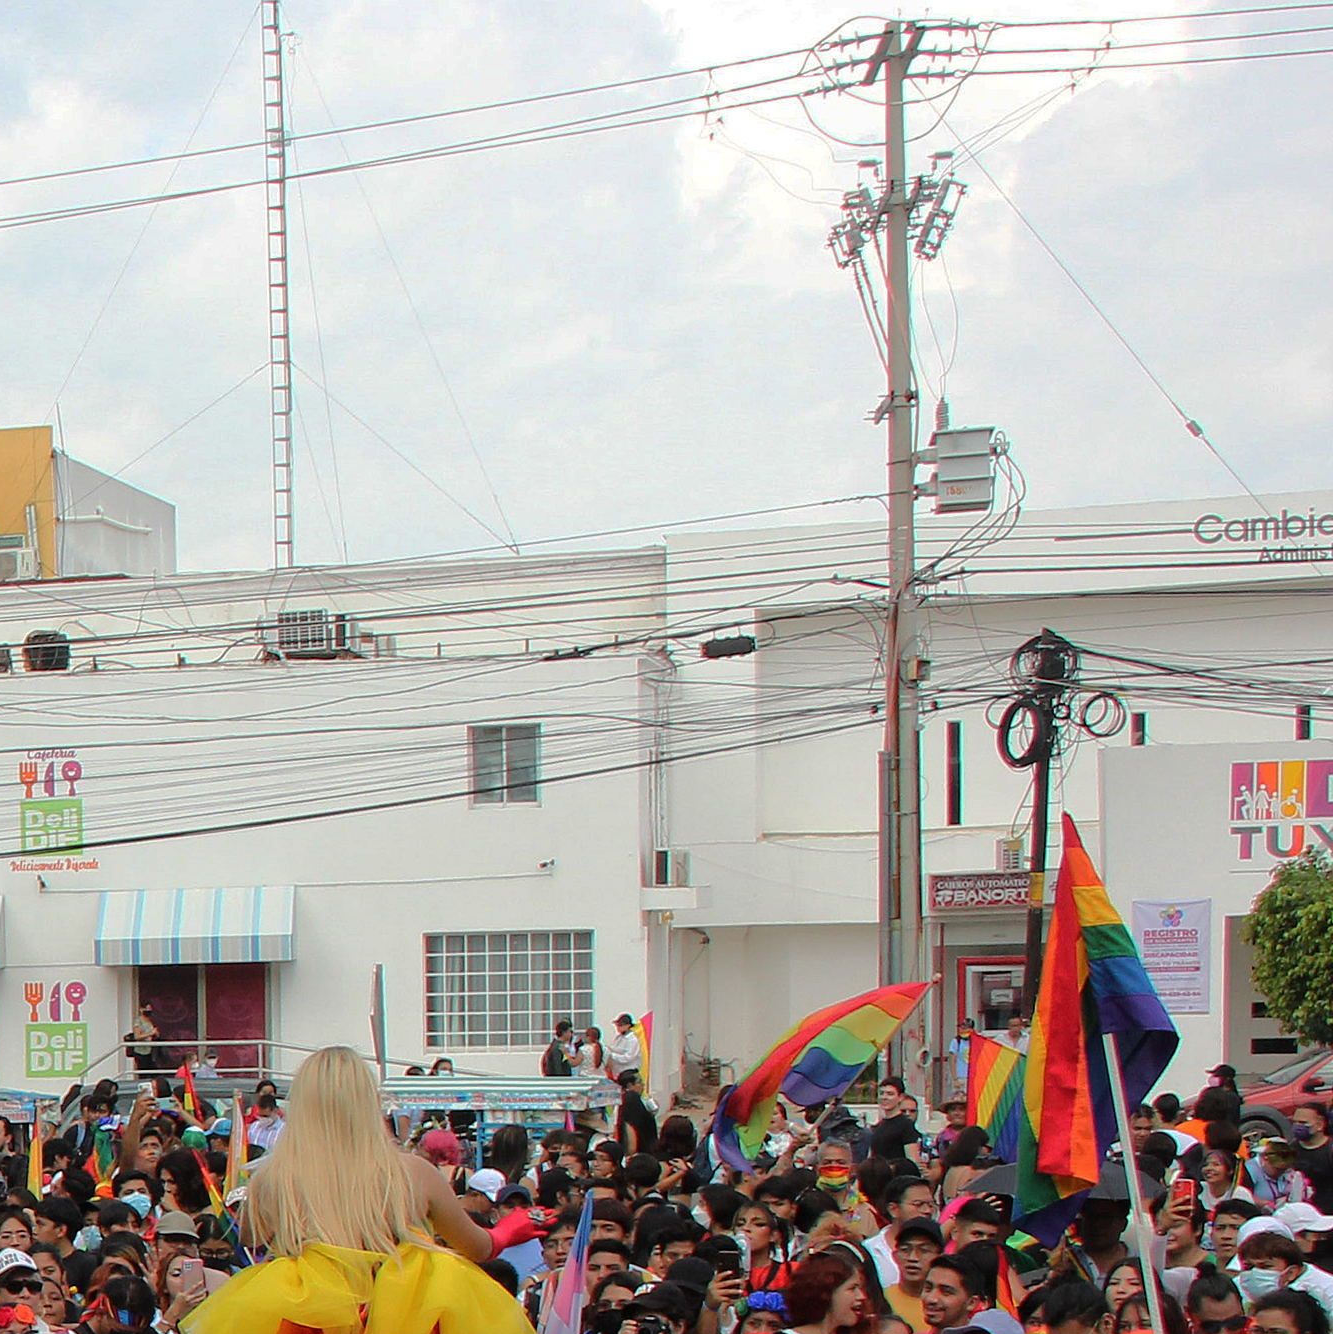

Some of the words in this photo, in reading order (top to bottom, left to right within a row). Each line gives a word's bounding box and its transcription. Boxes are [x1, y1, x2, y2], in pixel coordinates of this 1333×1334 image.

[24, 807, 79, 828] Deli
[24, 829, 80, 850] DIF
[954, 888, 1029, 902] BANORT
[1144, 929, 1198, 938] REGISTRO
[29, 1028, 83, 1049] Deli
[30, 1050, 84, 1072] DIF
